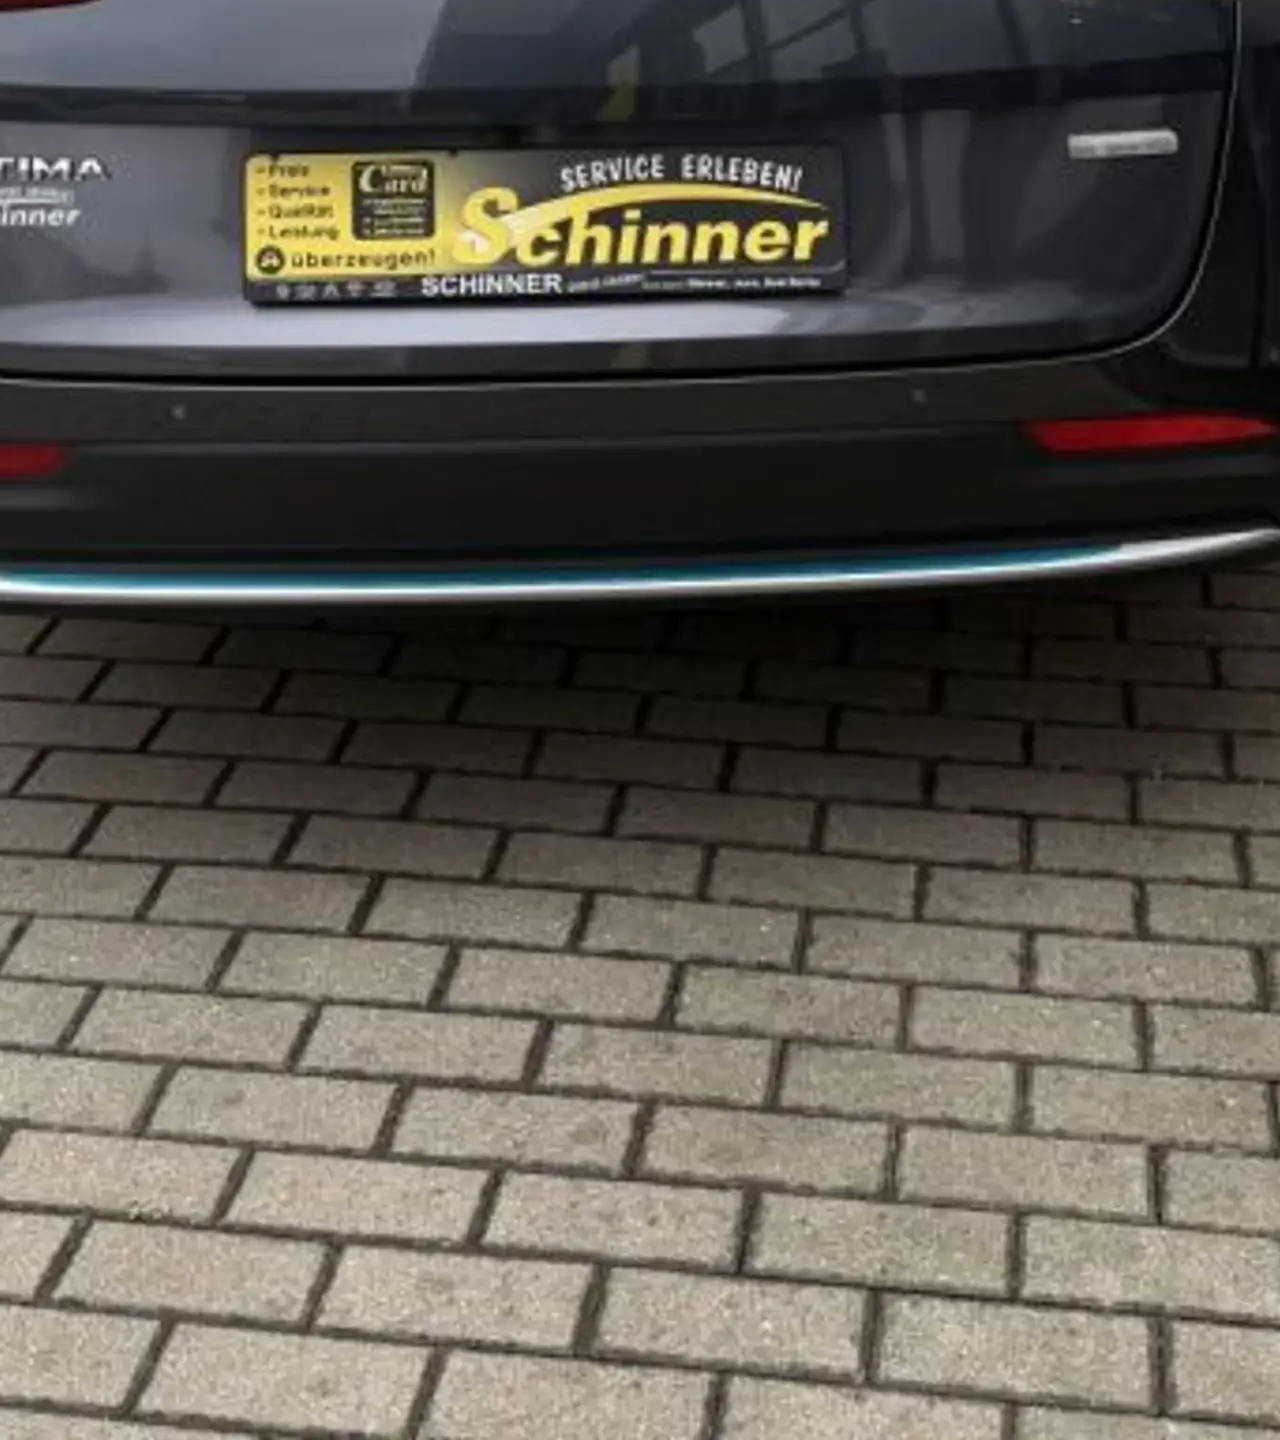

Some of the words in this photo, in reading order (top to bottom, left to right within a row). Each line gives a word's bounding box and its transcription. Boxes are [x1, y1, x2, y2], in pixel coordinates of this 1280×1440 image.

[560, 153, 665, 193] SERVICE
[680, 153, 804, 194] ERLEBEN!
[452, 186, 830, 267] Schinner
[421, 272, 564, 296] SCHINNER
